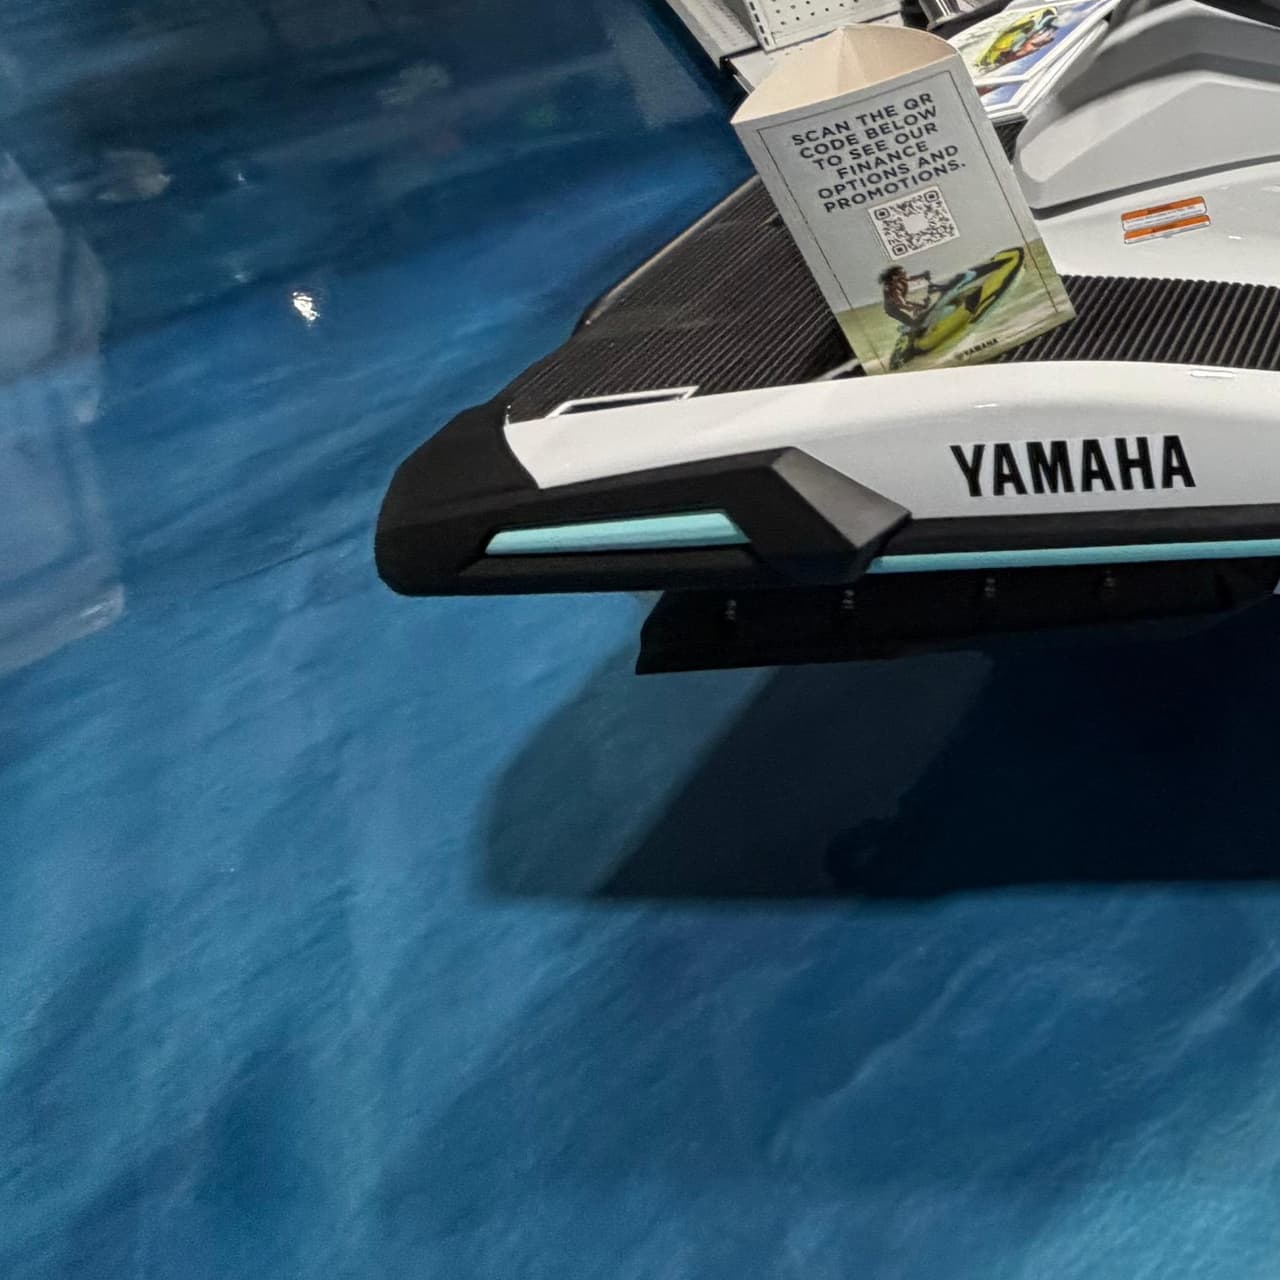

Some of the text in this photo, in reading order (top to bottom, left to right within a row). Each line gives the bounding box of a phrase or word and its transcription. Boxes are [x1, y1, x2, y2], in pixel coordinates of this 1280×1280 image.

[792, 93, 934, 146] SCAN THE QR
[800, 106, 937, 159] CODE BELOW
[812, 122, 938, 170] TO SEE OUR
[818, 145, 959, 200] OPTIONS AND
[823, 160, 966, 213] PROMOTIONS.
[836, 141, 929, 180] FINANCE
[949, 434, 1197, 498] YAMAHA
